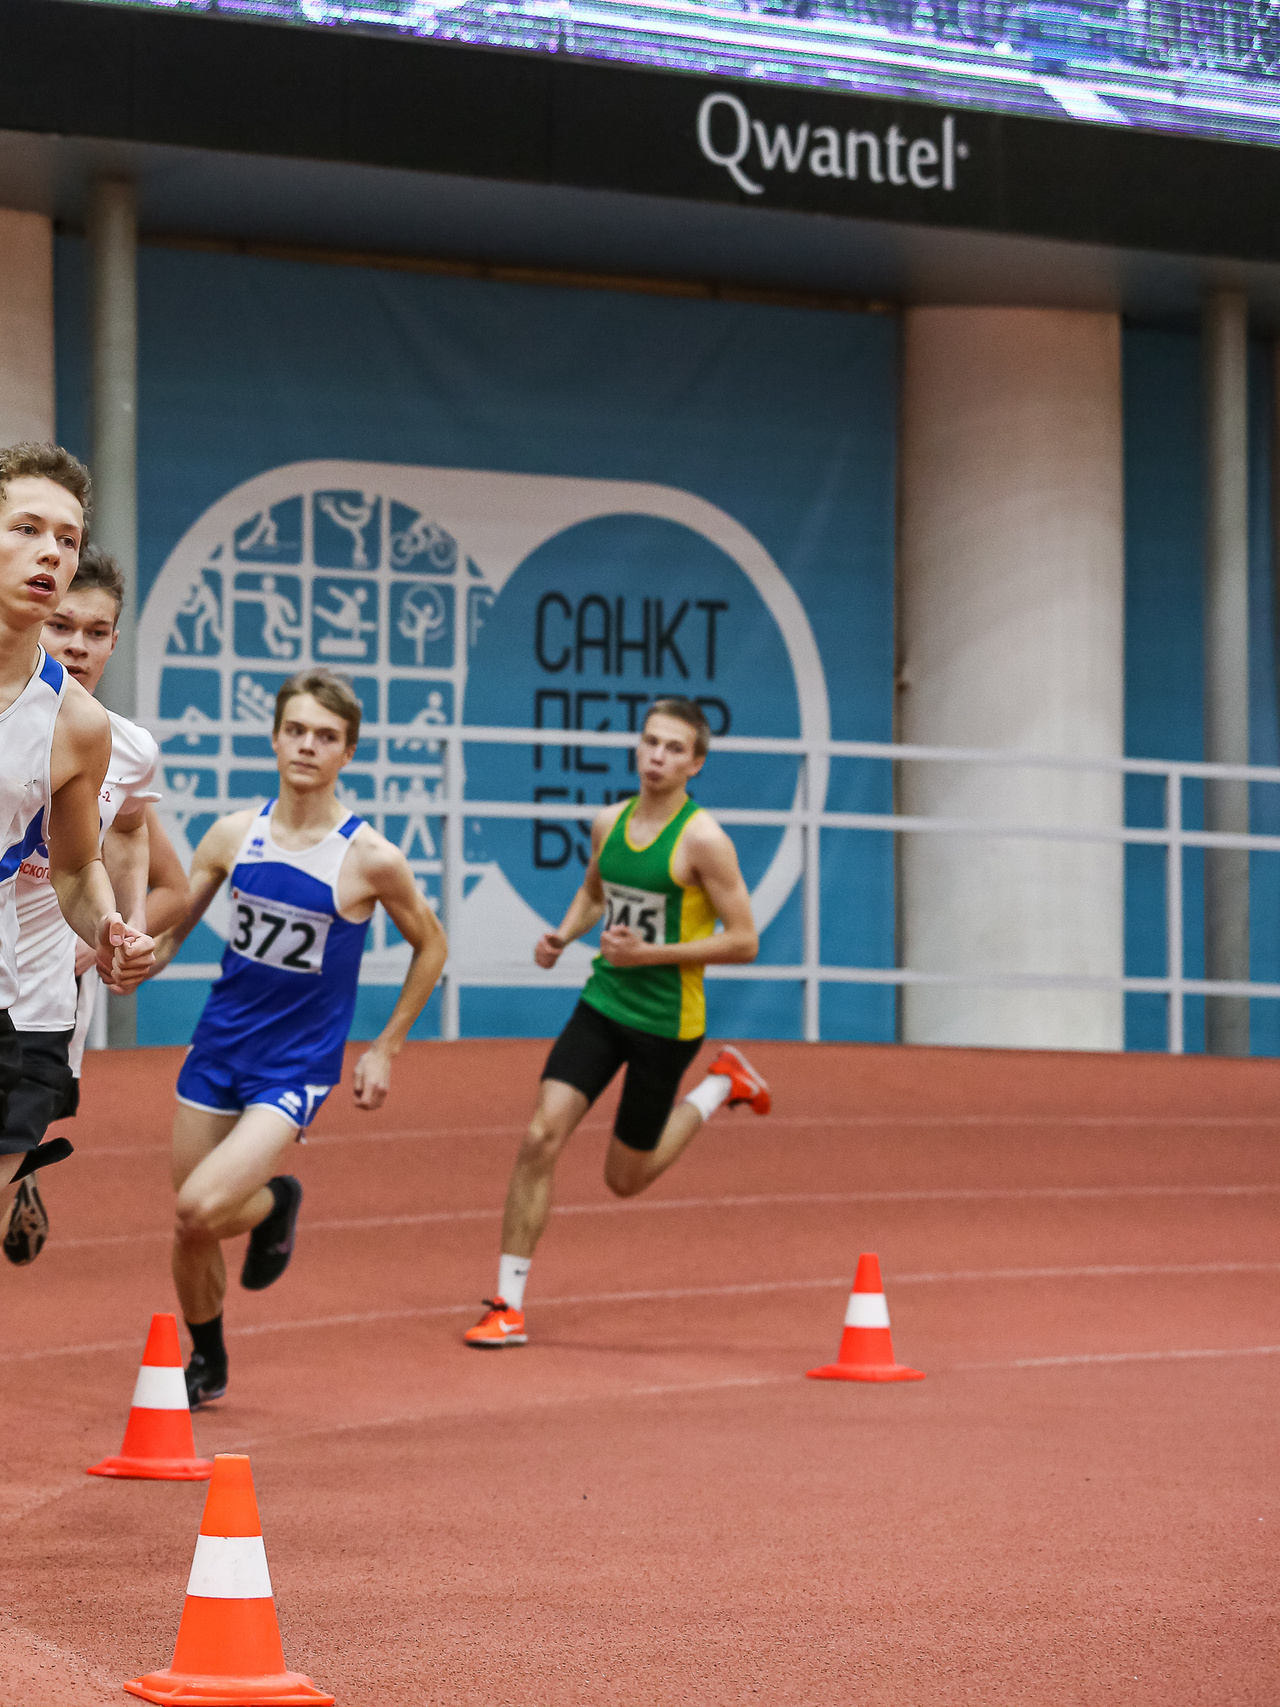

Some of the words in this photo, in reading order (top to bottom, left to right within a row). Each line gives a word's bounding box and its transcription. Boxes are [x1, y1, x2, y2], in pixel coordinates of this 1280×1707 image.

[697, 91, 956, 195] Qwantel
[533, 590, 729, 681] САНКТ
[233, 904, 317, 969] 372
